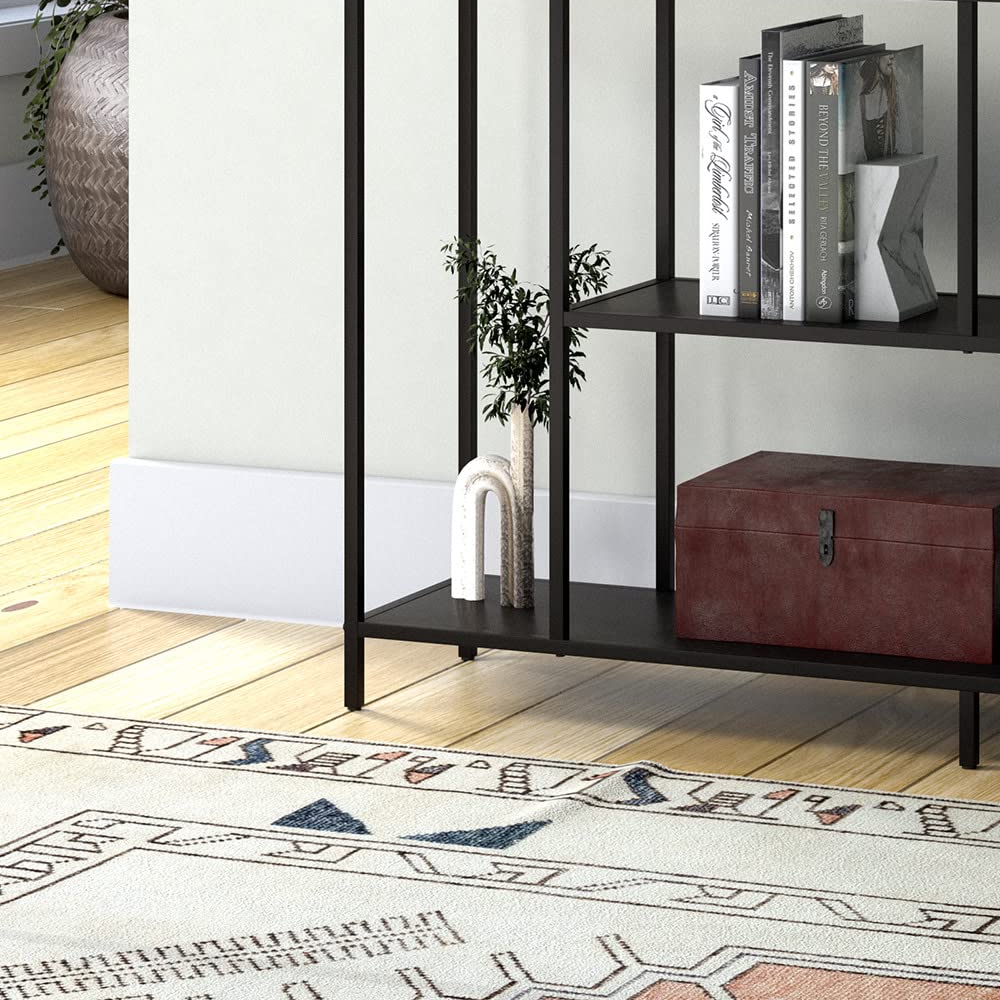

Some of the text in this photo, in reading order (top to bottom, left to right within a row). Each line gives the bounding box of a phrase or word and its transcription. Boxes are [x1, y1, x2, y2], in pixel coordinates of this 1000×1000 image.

[704, 99, 732, 143] Girl
[744, 70, 757, 194] AMIDST TRAFFIC
[788, 85, 796, 225] SELECTED STORIES
[818, 104, 829, 211] BEYOND THE VALLEY
[707, 152, 732, 220] Limberlost
